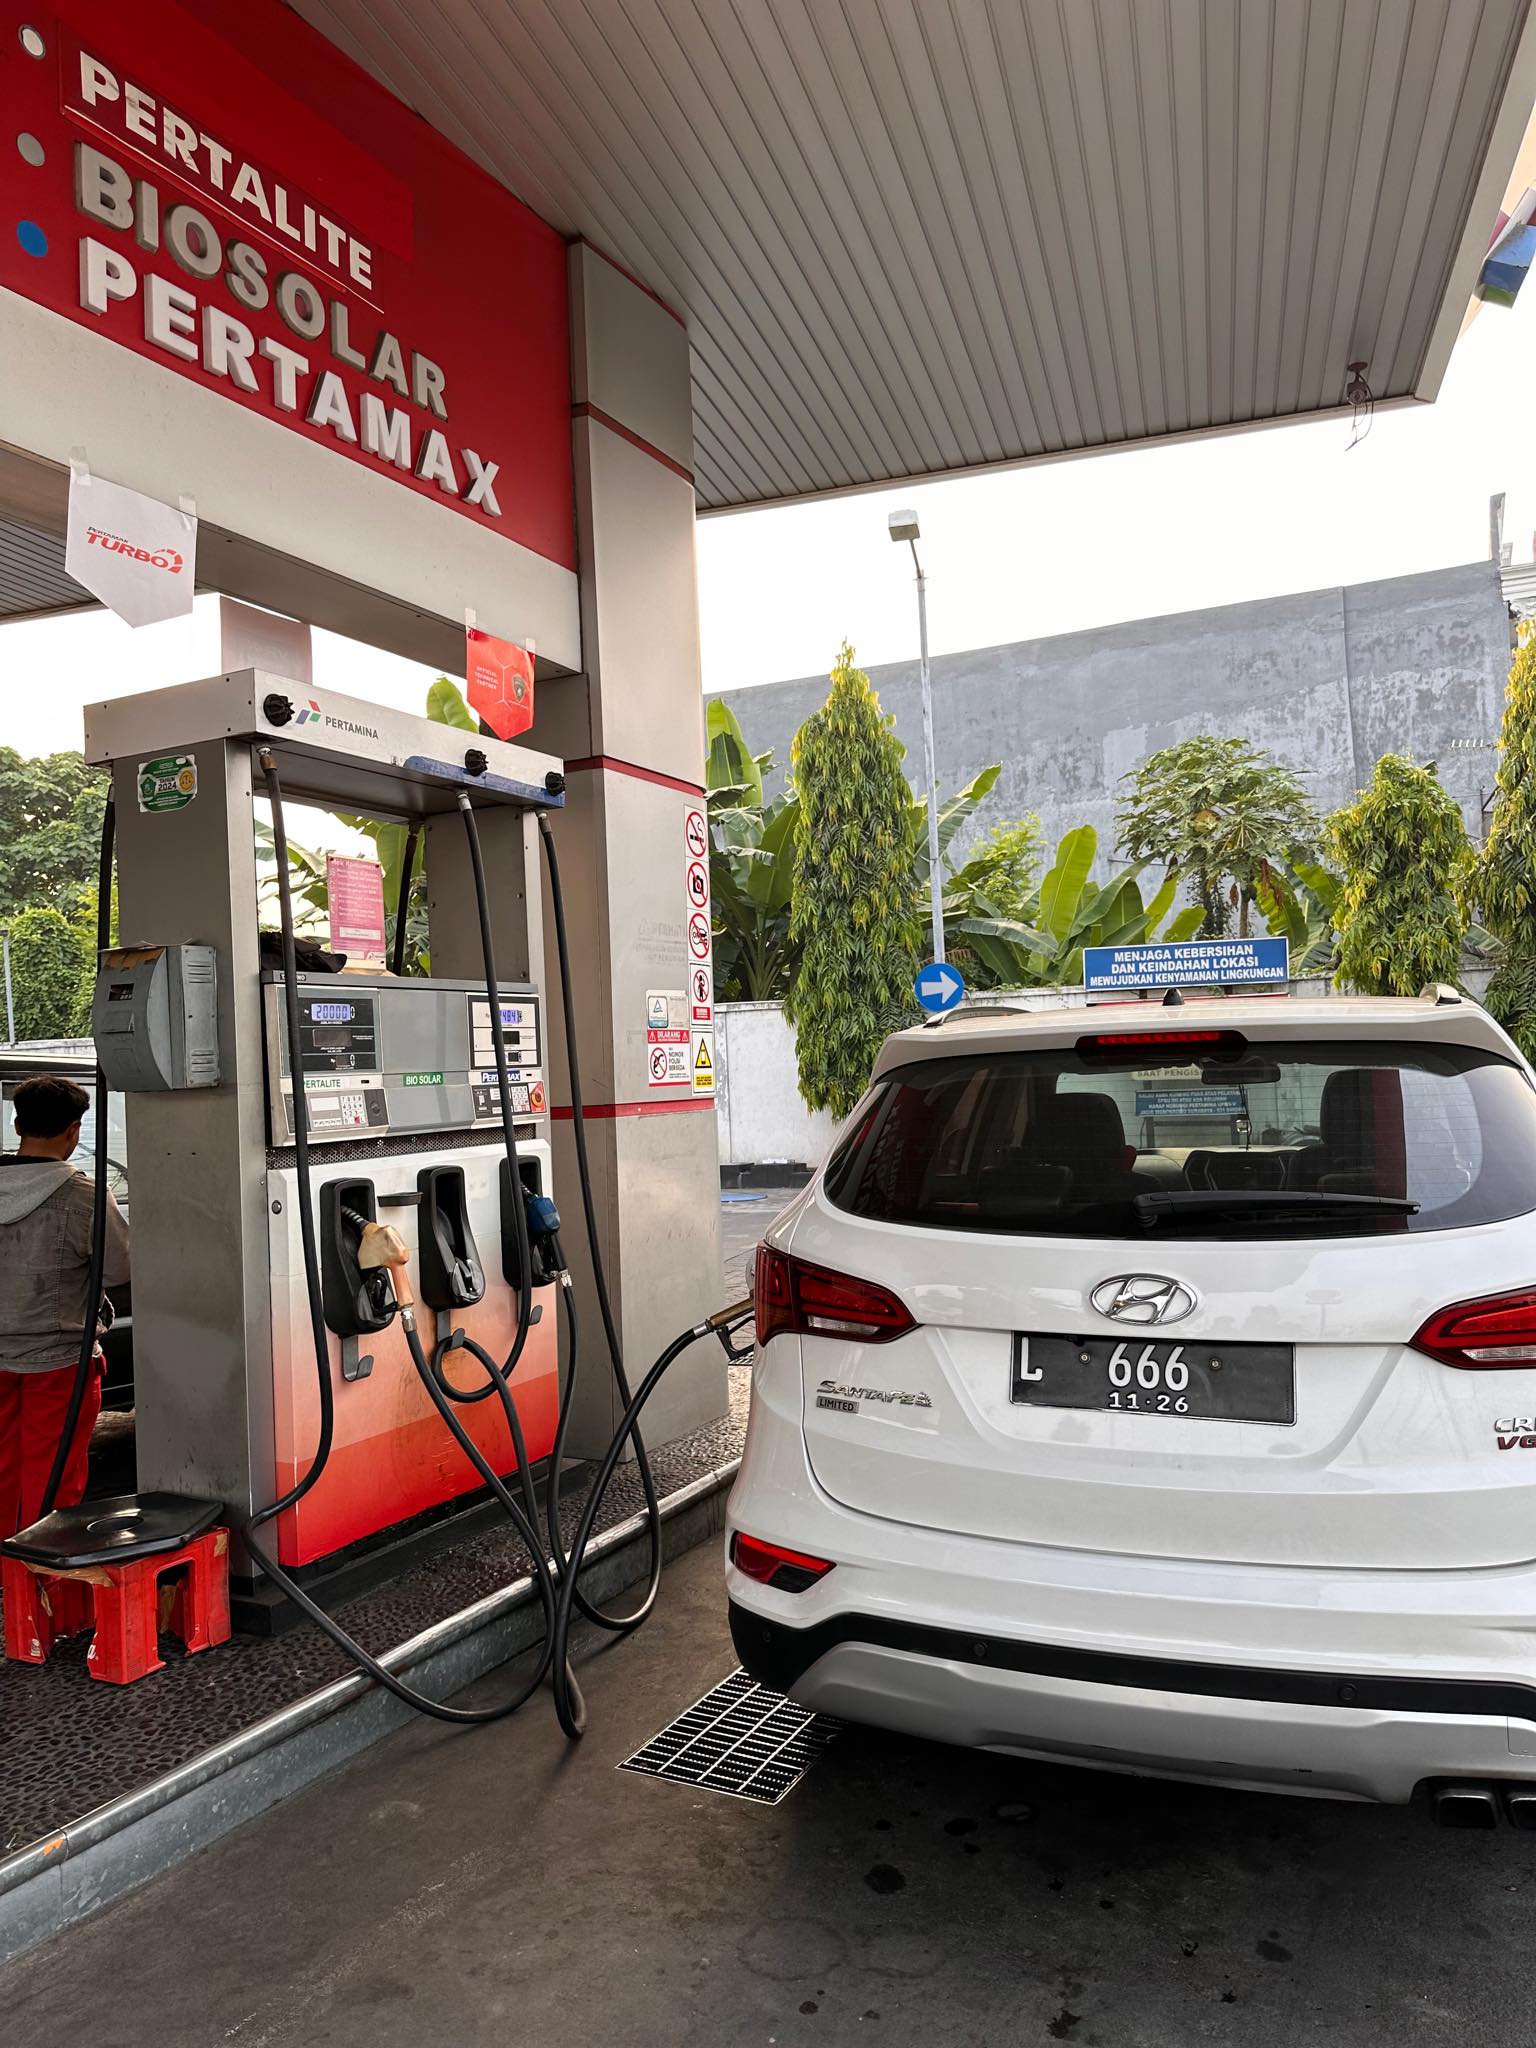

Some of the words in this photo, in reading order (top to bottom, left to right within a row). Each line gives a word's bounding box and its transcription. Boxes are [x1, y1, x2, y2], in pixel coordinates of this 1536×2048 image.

[79, 50, 373, 291] PERTALITE
[74, 140, 449, 422] BIOSOLAR
[79, 236, 502, 517] PERTAMAX
[86, 531, 169, 568] TURBO
[325, 716, 379, 740] PERTAMINA
[158, 782, 177, 792] 2024
[1114, 950, 1172, 962] MENJAGA
[1174, 945, 1253, 958] KEBERSIHAN
[1111, 962, 1136, 974] DAN
[1139, 959, 1210, 973] KEINDAHAN
[1213, 956, 1259, 968] LOKASI
[1090, 974, 1153, 986] MEWUJUDKAN
[1155, 970, 1218, 984] KENYAMANAN
[1221, 967, 1284, 979] LINGKUNGAN
[304, 1079, 342, 1089] ERTALITE
[406, 1076, 418, 1085] BIO
[419, 1074, 442, 1085] SOLAR
[1020, 1337, 1043, 1381] L
[1108, 1342, 1189, 1392] 666
[819, 1398, 855, 1412] LIMITED
